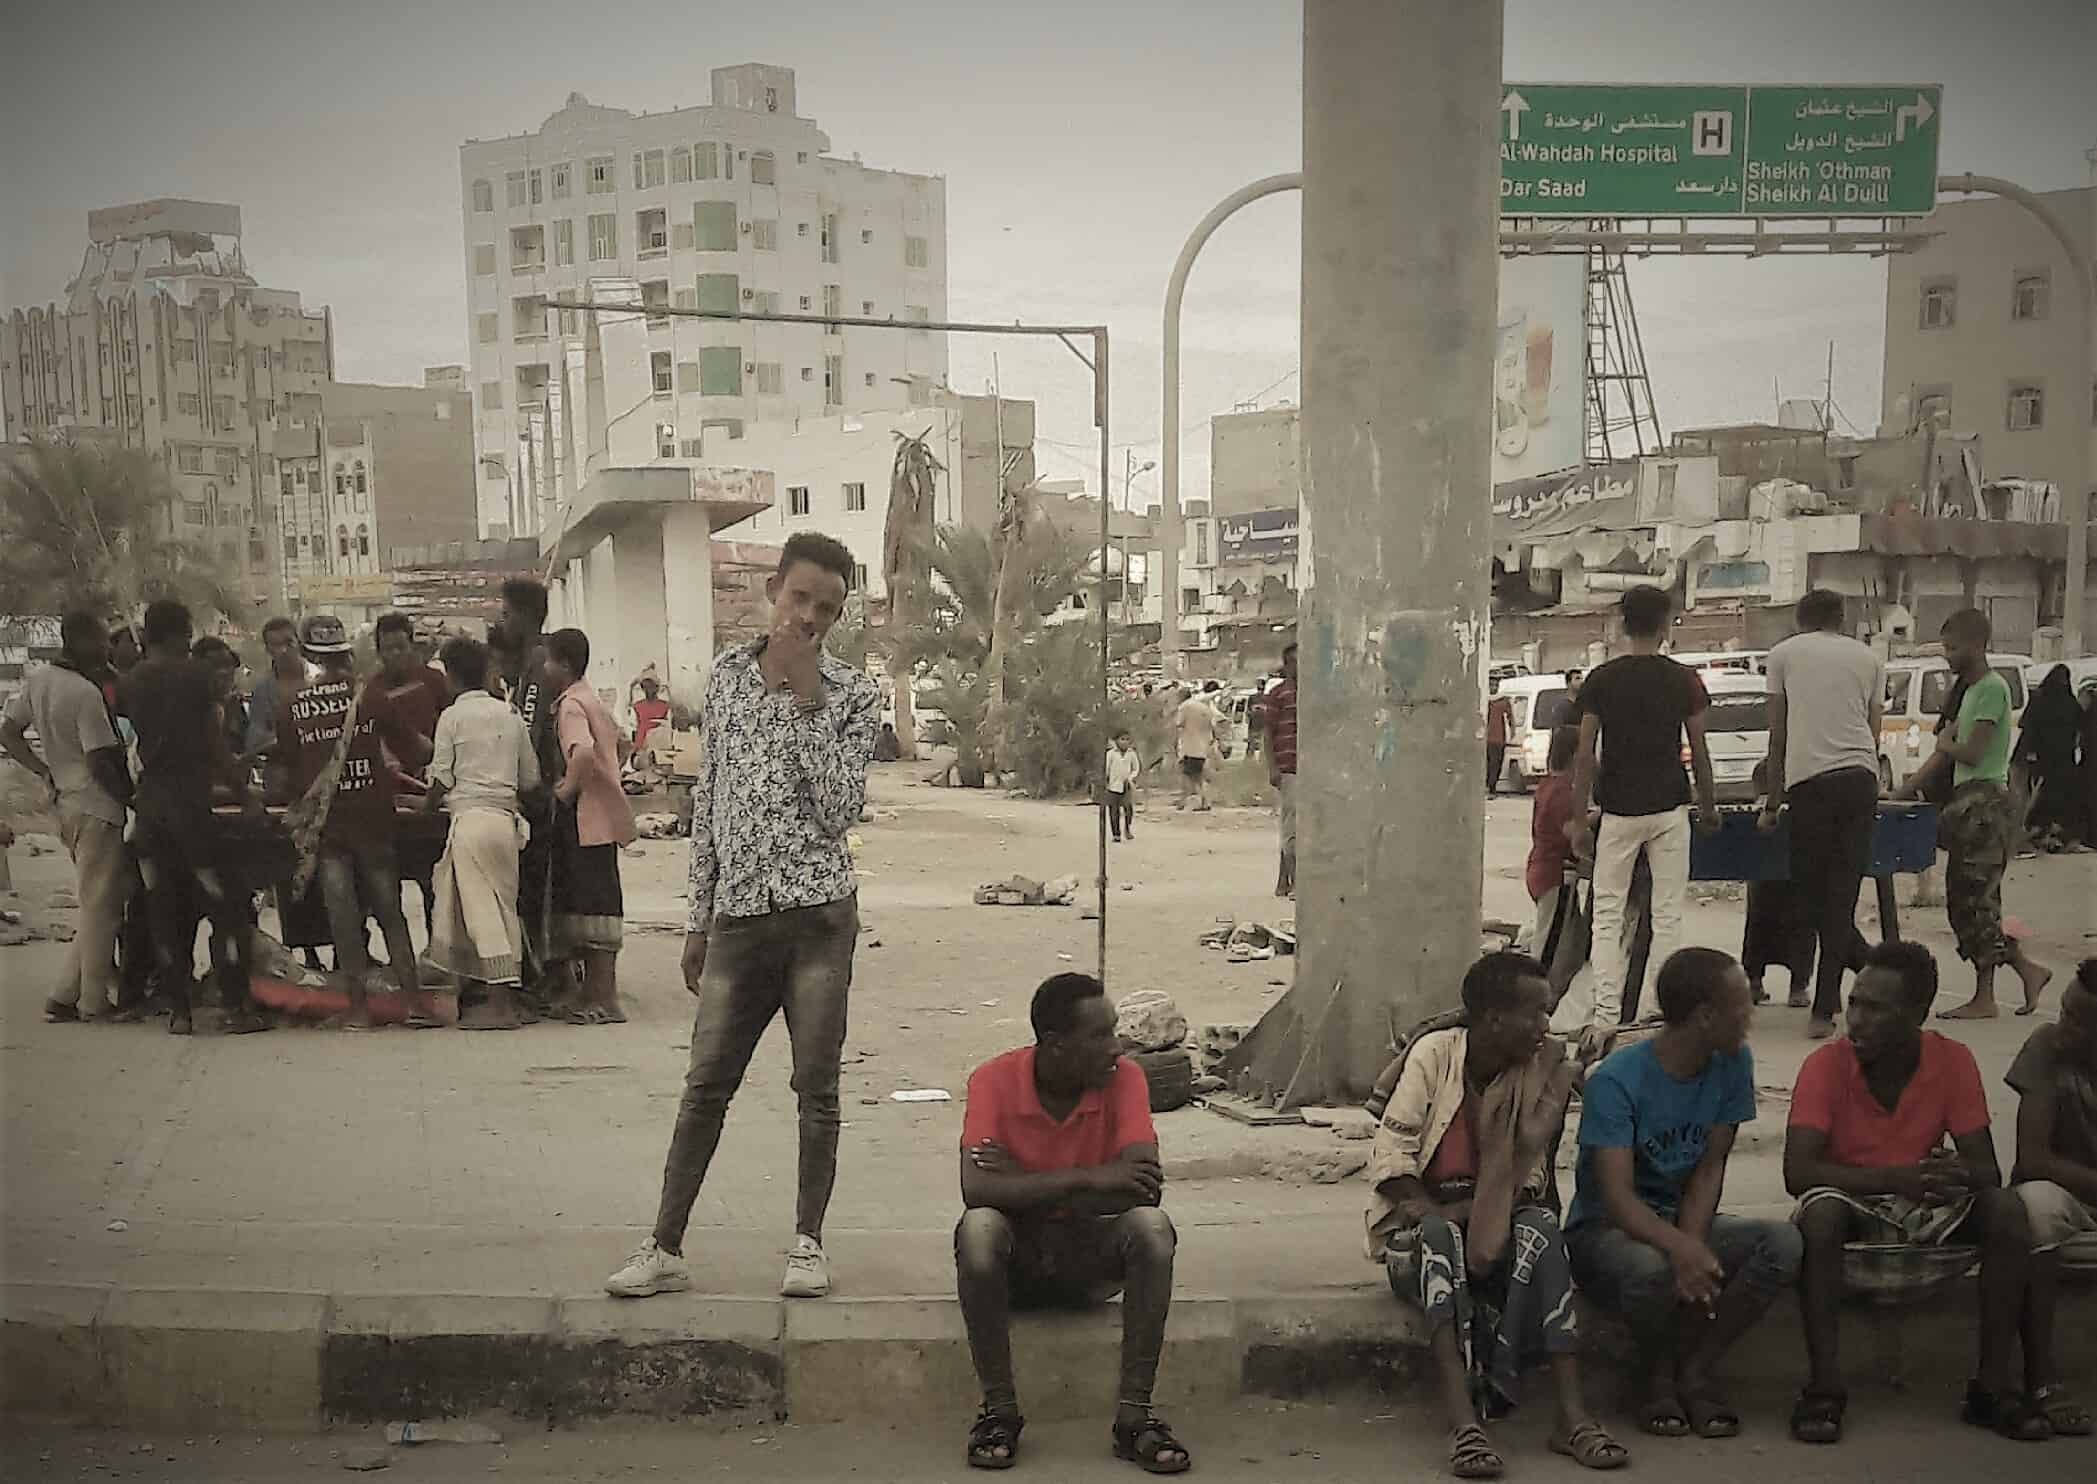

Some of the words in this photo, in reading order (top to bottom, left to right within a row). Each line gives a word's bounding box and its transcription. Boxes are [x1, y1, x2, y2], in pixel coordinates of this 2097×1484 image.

[1795, 97, 1842, 120] عثمان
[1847, 98, 1894, 120] الشيخ
[1544, 111, 1604, 130] الوحدة
[1701, 118, 1723, 149] H
[1845, 131, 1893, 153] الشيخ
[1600, 143, 1678, 165] Hospital
[1748, 161, 1810, 181] Sheikh
[1500, 179, 1532, 197] Dar
[1538, 179, 1587, 198] Saad
[1747, 184, 1811, 204] Sheikh
[1817, 184, 1837, 204] Al
[297, 681, 348, 699] ertrand
